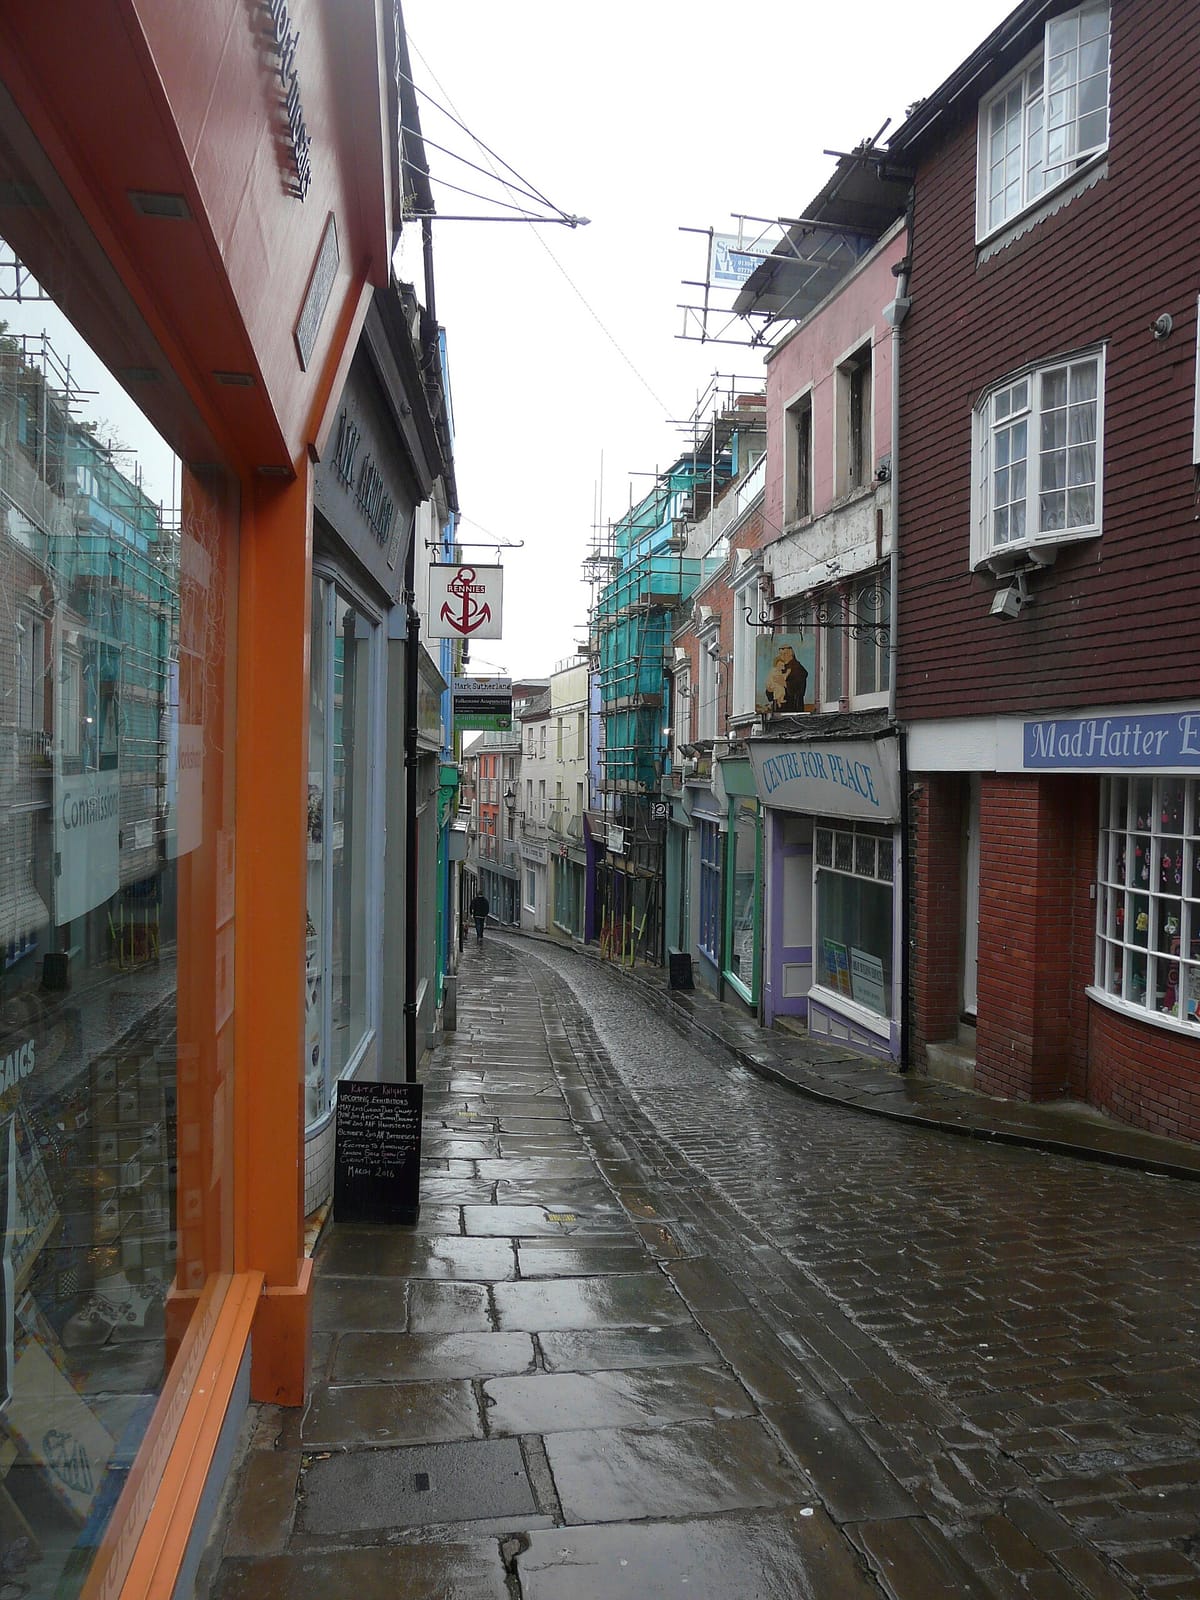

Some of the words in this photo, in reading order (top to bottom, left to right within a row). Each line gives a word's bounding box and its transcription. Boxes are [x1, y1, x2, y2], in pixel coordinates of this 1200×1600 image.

[447, 585, 486, 594] RENNIES
[454, 682, 472, 690] Mark
[472, 682, 512, 690] Sutherland
[1030, 719, 1169, 758] MadHatter
[762, 752, 801, 794] CENTRE
[799, 751, 829, 780] FOR
[826, 753, 880, 806] PEACE
[382, 1084, 409, 1097] KNIGHT
[374, 1166, 395, 1178] 2016
